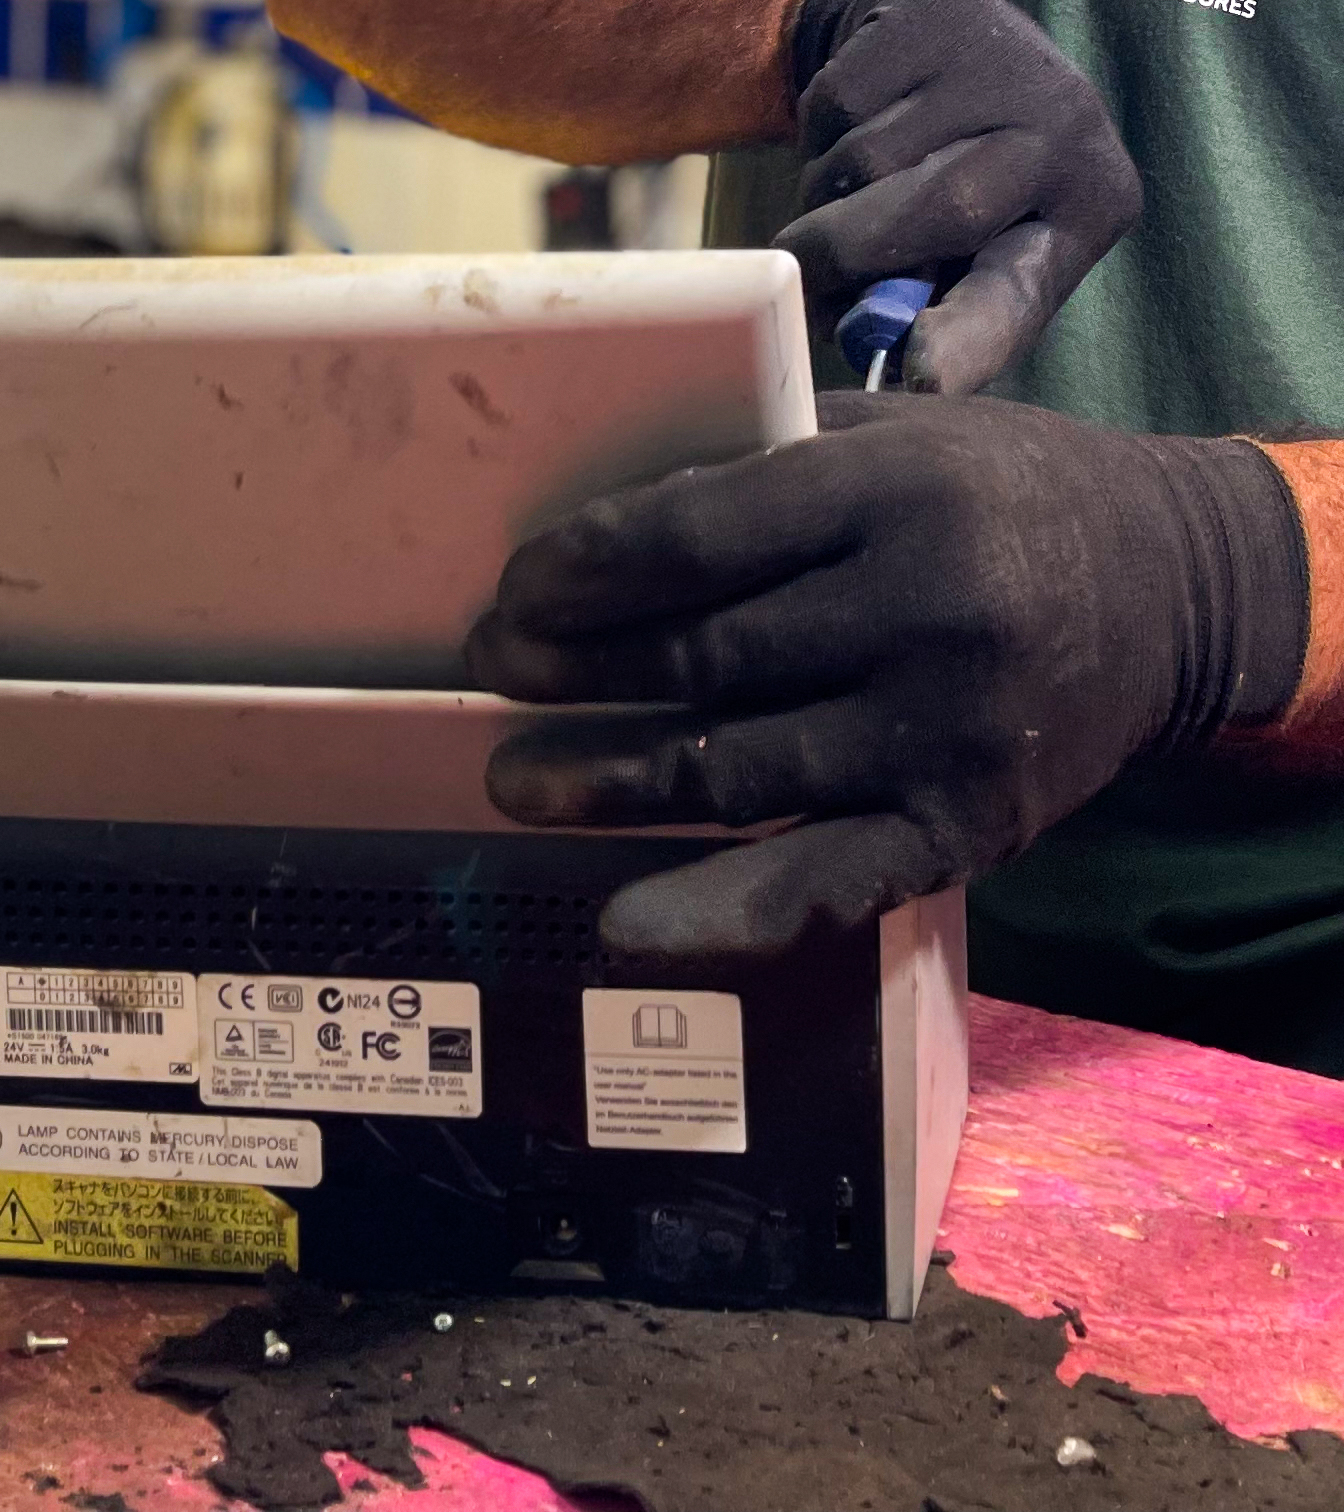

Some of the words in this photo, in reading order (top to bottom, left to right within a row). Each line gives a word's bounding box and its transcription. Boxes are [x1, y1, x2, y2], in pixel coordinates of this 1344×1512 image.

[347, 994, 381, 1010] N124
[3, 1041, 25, 1053] 24V
[4, 1053, 38, 1065] MADE
[41, 1054, 53, 1065] IN
[57, 1055, 94, 1066] CHINA
[18, 1124, 58, 1139] LAMP
[66, 1127, 142, 1144] CONTAINS
[231, 1135, 299, 1152] DISPOSE
[18, 1143, 111, 1161] ACCORDING
[119, 1148, 140, 1163] TO
[148, 1148, 195, 1165] STATE
[207, 1152, 258, 1169] LOCAL
[265, 1155, 299, 1170] LAW
[54, 1220, 116, 1238] INSTALL
[125, 1223, 213, 1244] SOFTWARE
[223, 1229, 288, 1249] BEFORE
[53, 1239, 135, 1260] PLUGGING
[145, 1244, 161, 1261] IN
[172, 1246, 202, 1264] THE
